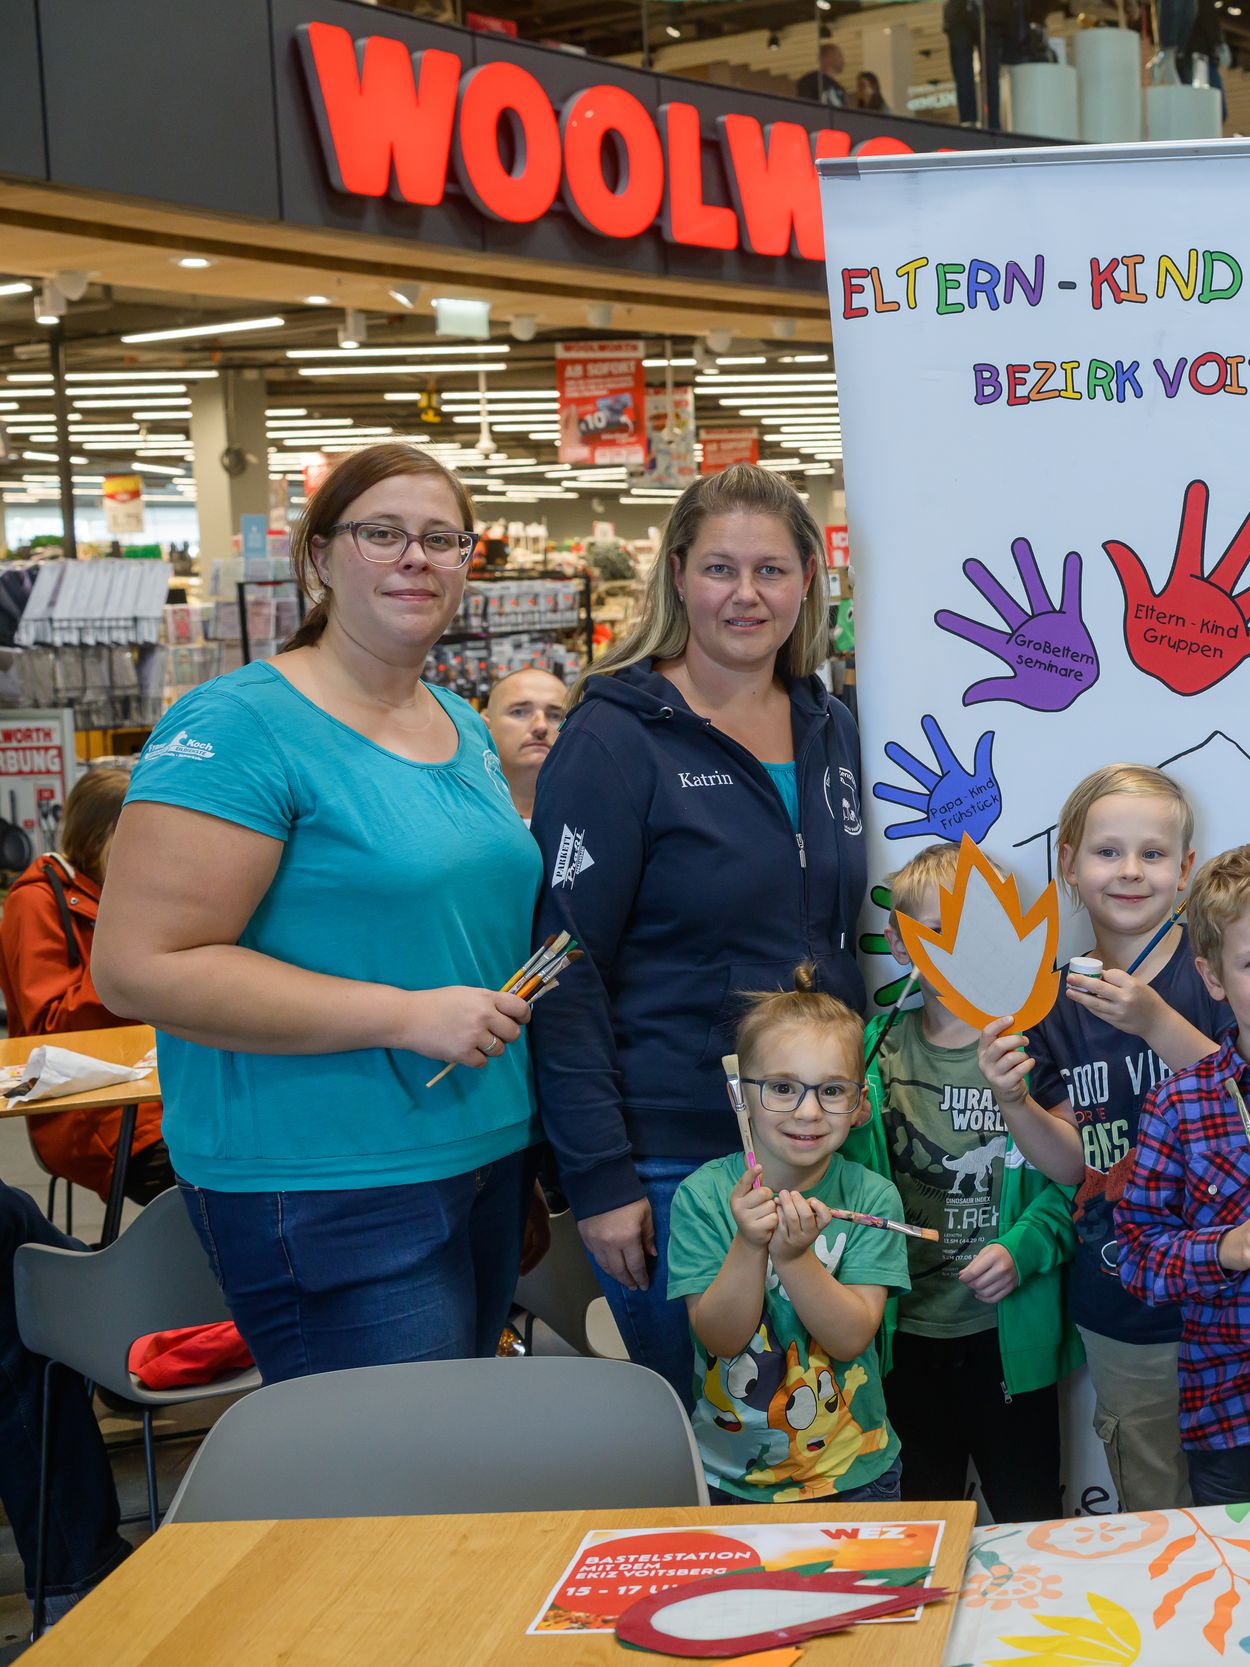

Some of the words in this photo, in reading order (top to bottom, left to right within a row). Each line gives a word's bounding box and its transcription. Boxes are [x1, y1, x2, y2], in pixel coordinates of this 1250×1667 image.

[296, 20, 915, 262] WOOLW
[841, 254, 1045, 320] ELTERN
[1090, 248, 1243, 310] KIND
[973, 358, 1143, 406] BEZIRK
[1134, 603, 1186, 628] Eltern
[1200, 618, 1239, 640] Kind
[1143, 627, 1224, 660] Gruppen
[1016, 653, 1085, 683] seminare
[0, 728, 53, 743] WORTH
[186, 739, 214, 752] Koch
[677, 770, 735, 788] Katrin
[930, 796, 964, 819] Papa
[968, 777, 995, 800] Kind
[940, 793, 1000, 831] Frühstück
[555, 834, 571, 878] PARKETT
[941, 1086, 1000, 1111] JURA
[952, 1110, 1008, 1132] WORL
[945, 1197, 974, 1205] DINOSAUR
[975, 1195, 990, 1203] INDEX
[579, 1563, 616, 1572] MIT
[618, 1562, 661, 1571] DEM
[585, 1551, 752, 1566] BASTELSTATION
[575, 1570, 618, 1580] EKIZ
[623, 1567, 728, 1578] VOITSBERG
[565, 1586, 592, 1597] 15
[617, 1584, 643, 1596] 17
